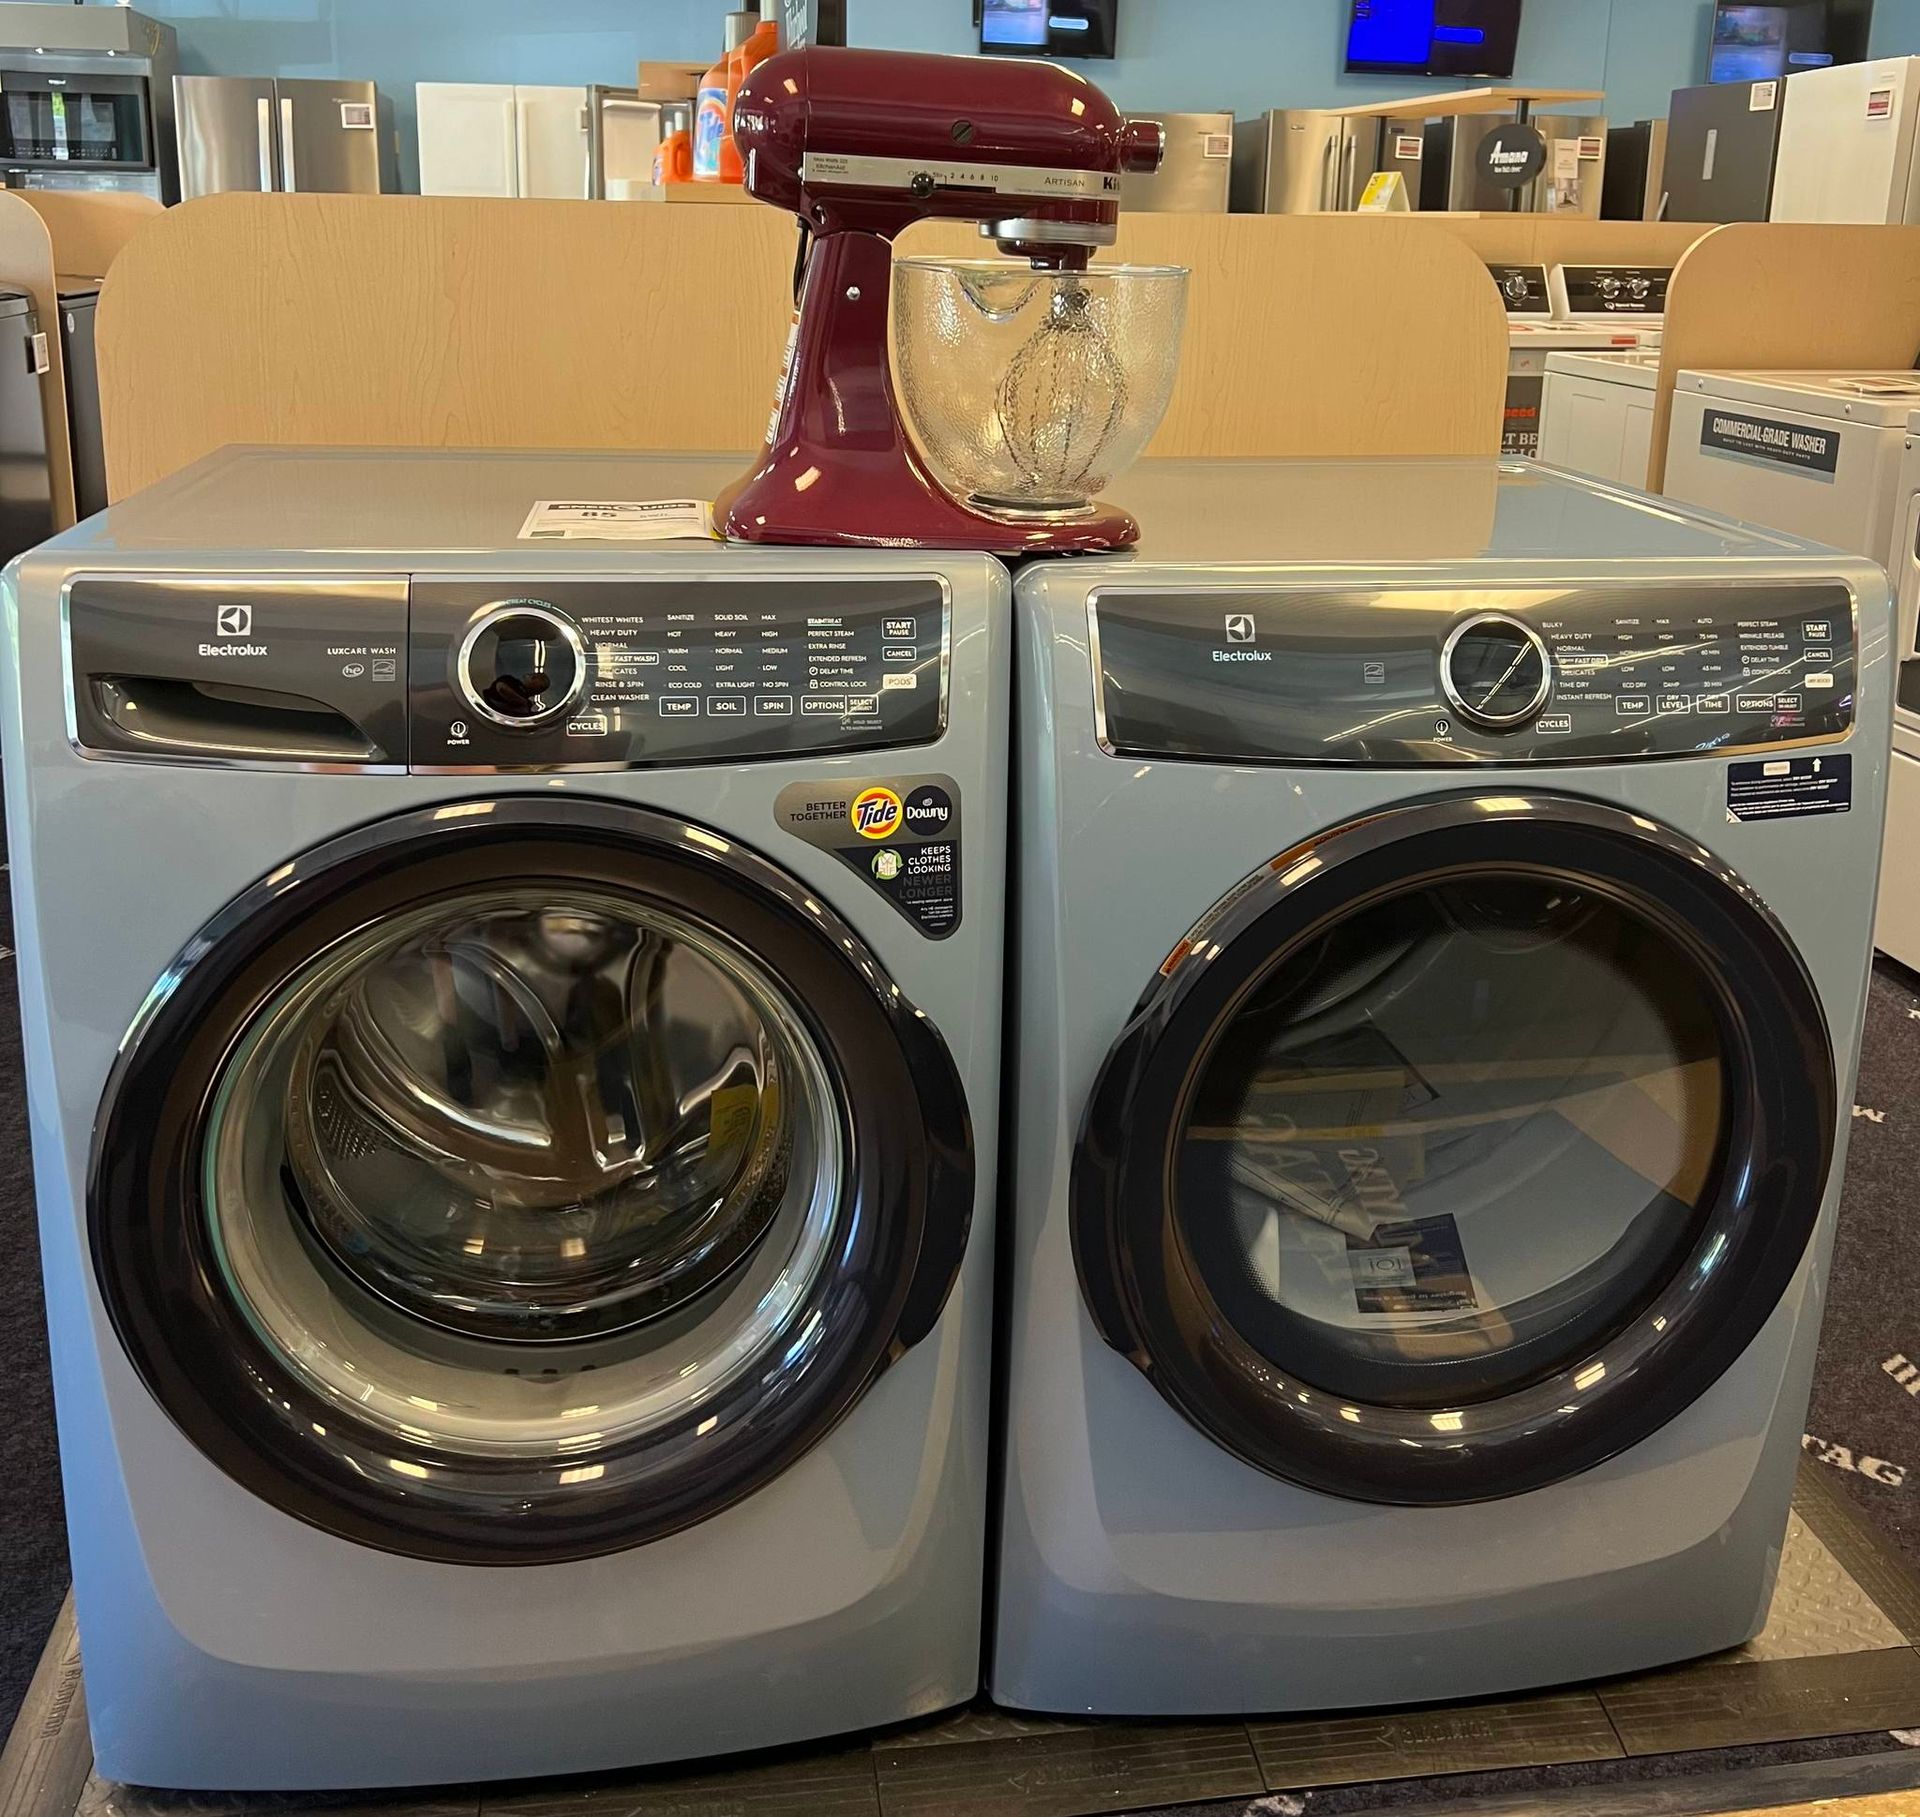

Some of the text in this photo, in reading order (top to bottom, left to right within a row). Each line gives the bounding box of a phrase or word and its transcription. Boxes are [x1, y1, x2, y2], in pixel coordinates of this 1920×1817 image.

[1489, 140, 1529, 164] Amana
[1713, 417, 1826, 455] COMMERCIAL-GRADE WASHER
[582, 616, 614, 624] WHITEST
[886, 621, 912, 629] START
[1806, 624, 1827, 632] START
[198, 643, 268, 657] Electrolux
[327, 647, 396, 655] LUXCARE WASH
[1212, 650, 1272, 662] Electrolux
[618, 693, 650, 701] WASHER
[666, 703, 692, 711] TEMP
[716, 703, 737, 711] SOIL
[763, 702, 784, 710] SPIN
[805, 701, 844, 710] OPTIONS
[1740, 700, 1773, 708] OPTIONS
[569, 722, 604, 731] CYCLES
[1538, 720, 1569, 728] CYCLES
[806, 801, 846, 812] BETTER
[790, 810, 847, 822] TOGETHER
[856, 798, 898, 833] Tide
[906, 805, 949, 821] Downy
[921, 845, 951, 855] KEEPS
[908, 855, 951, 866] CLOTHES
[908, 864, 952, 875] LOOKING
[903, 873, 952, 887] NEWER
[900, 885, 953, 899] LONGER
